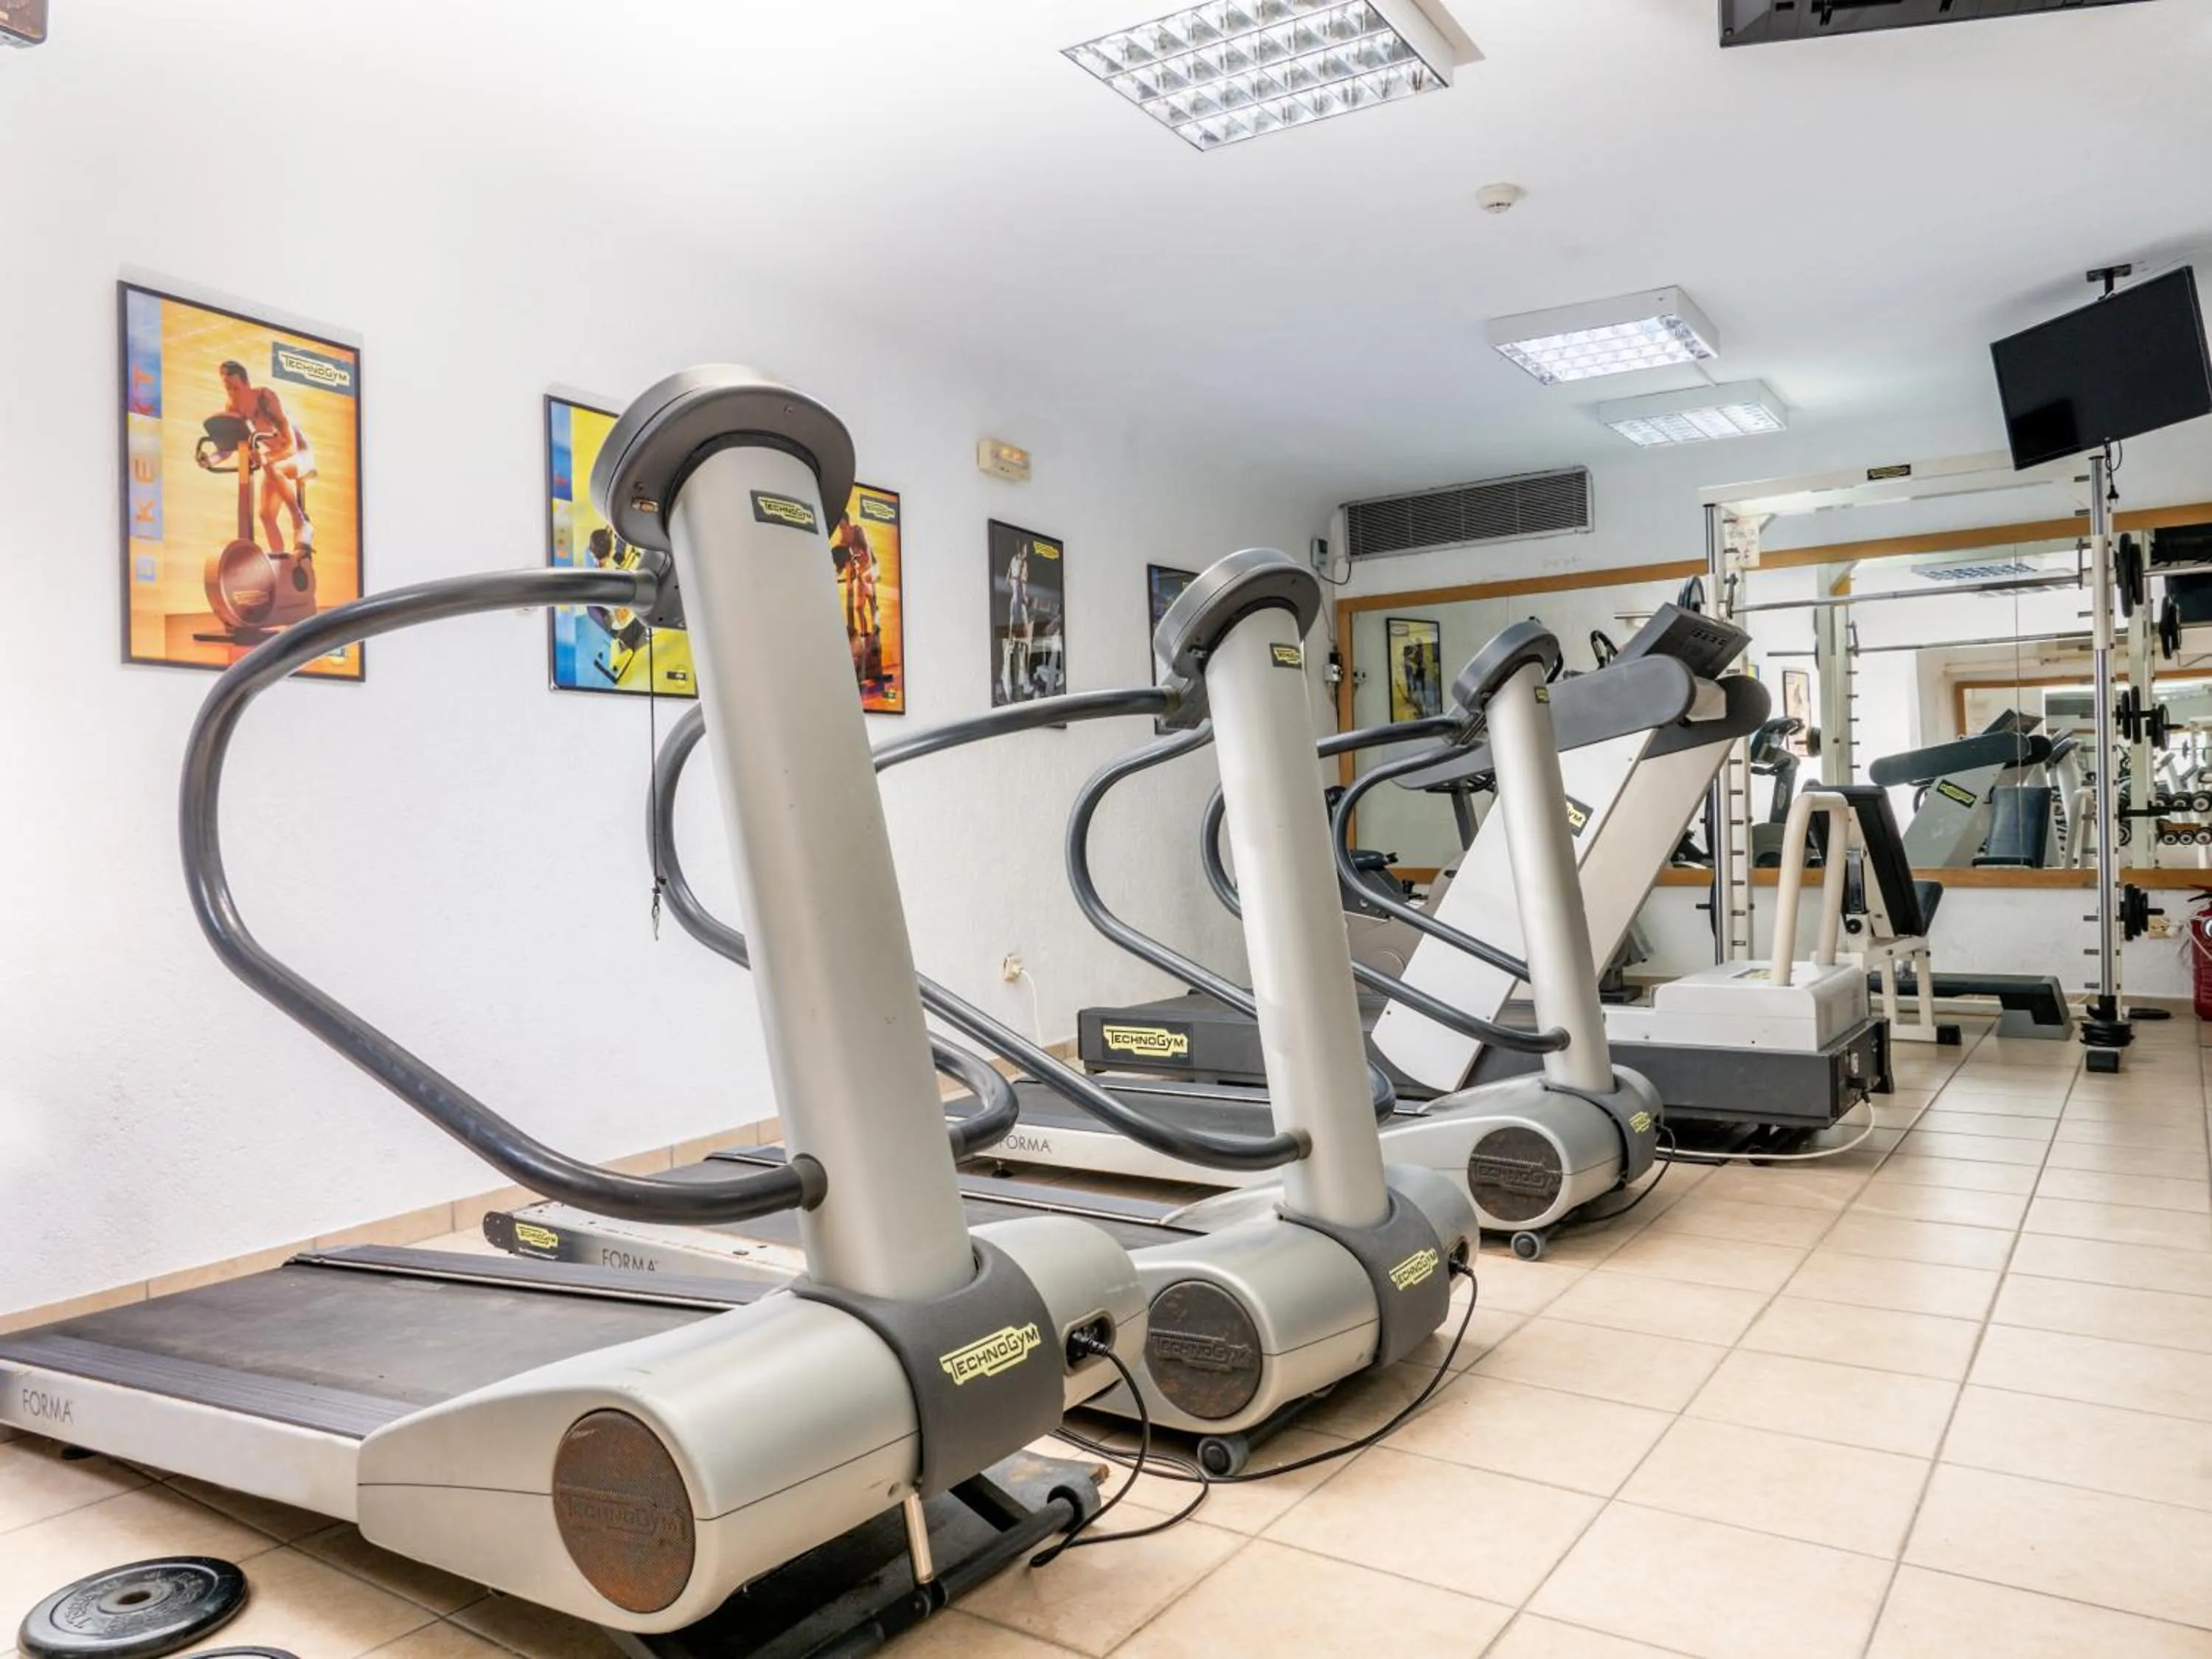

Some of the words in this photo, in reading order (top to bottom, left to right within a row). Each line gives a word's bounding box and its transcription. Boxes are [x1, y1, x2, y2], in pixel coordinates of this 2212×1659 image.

[1105, 1029, 1184, 1051] TECHNOGYM
[999, 1135, 1052, 1153] ORMA
[601, 1248, 656, 1272] FORMA
[942, 1327, 1038, 1380] TECHNOGYM
[22, 1388, 74, 1425] FORMA
